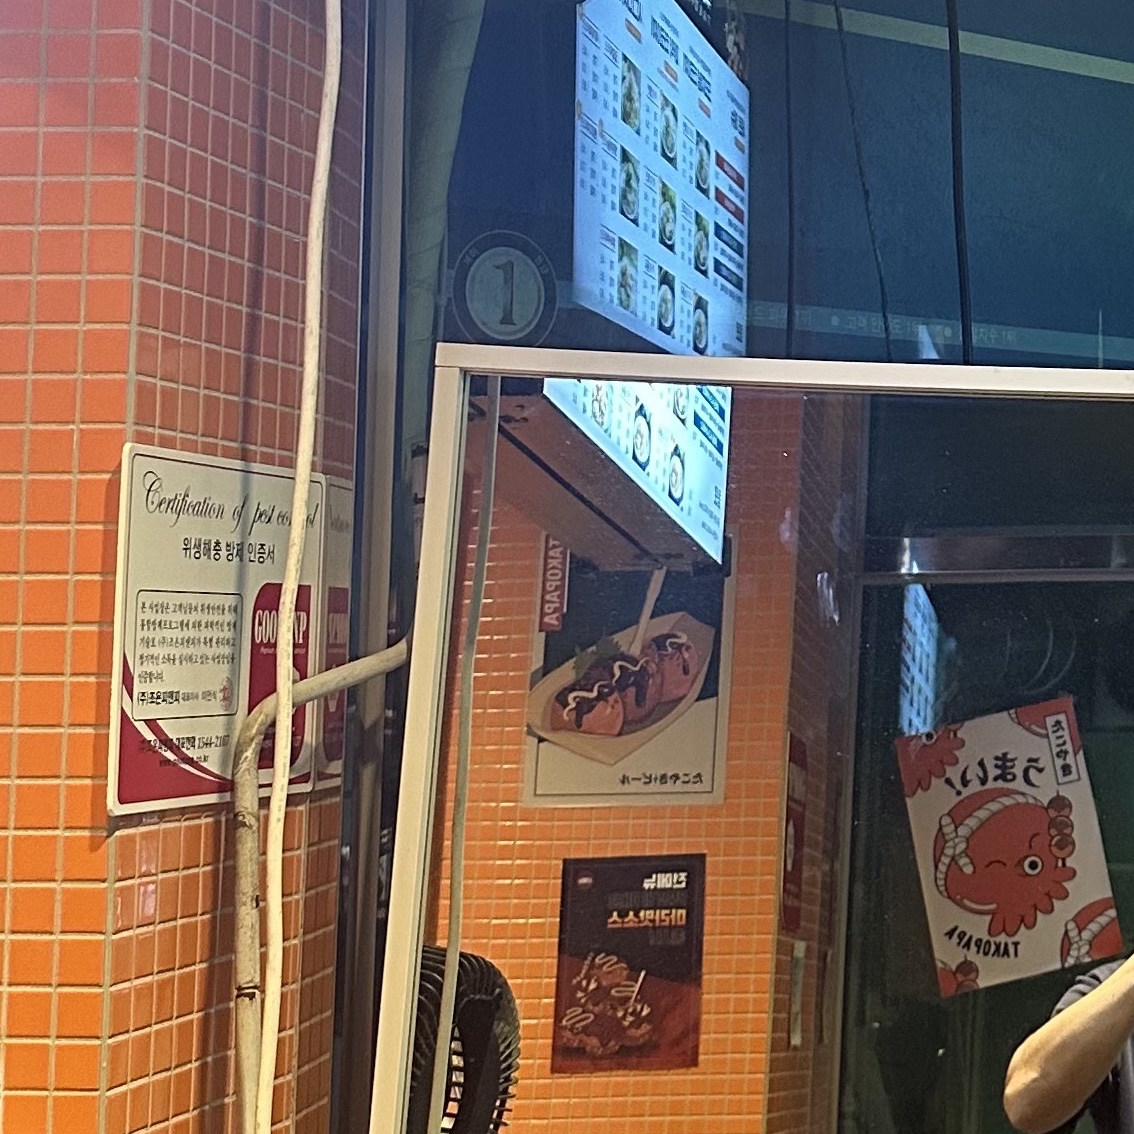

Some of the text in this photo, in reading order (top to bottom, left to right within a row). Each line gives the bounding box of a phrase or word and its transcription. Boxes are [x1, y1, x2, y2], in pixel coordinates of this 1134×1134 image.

[143, 471, 224, 528] Certification
[230, 493, 249, 534] of
[248, 501, 274, 535] pest
[182, 537, 222, 561] 위생해충
[247, 543, 275, 564] 인증서
